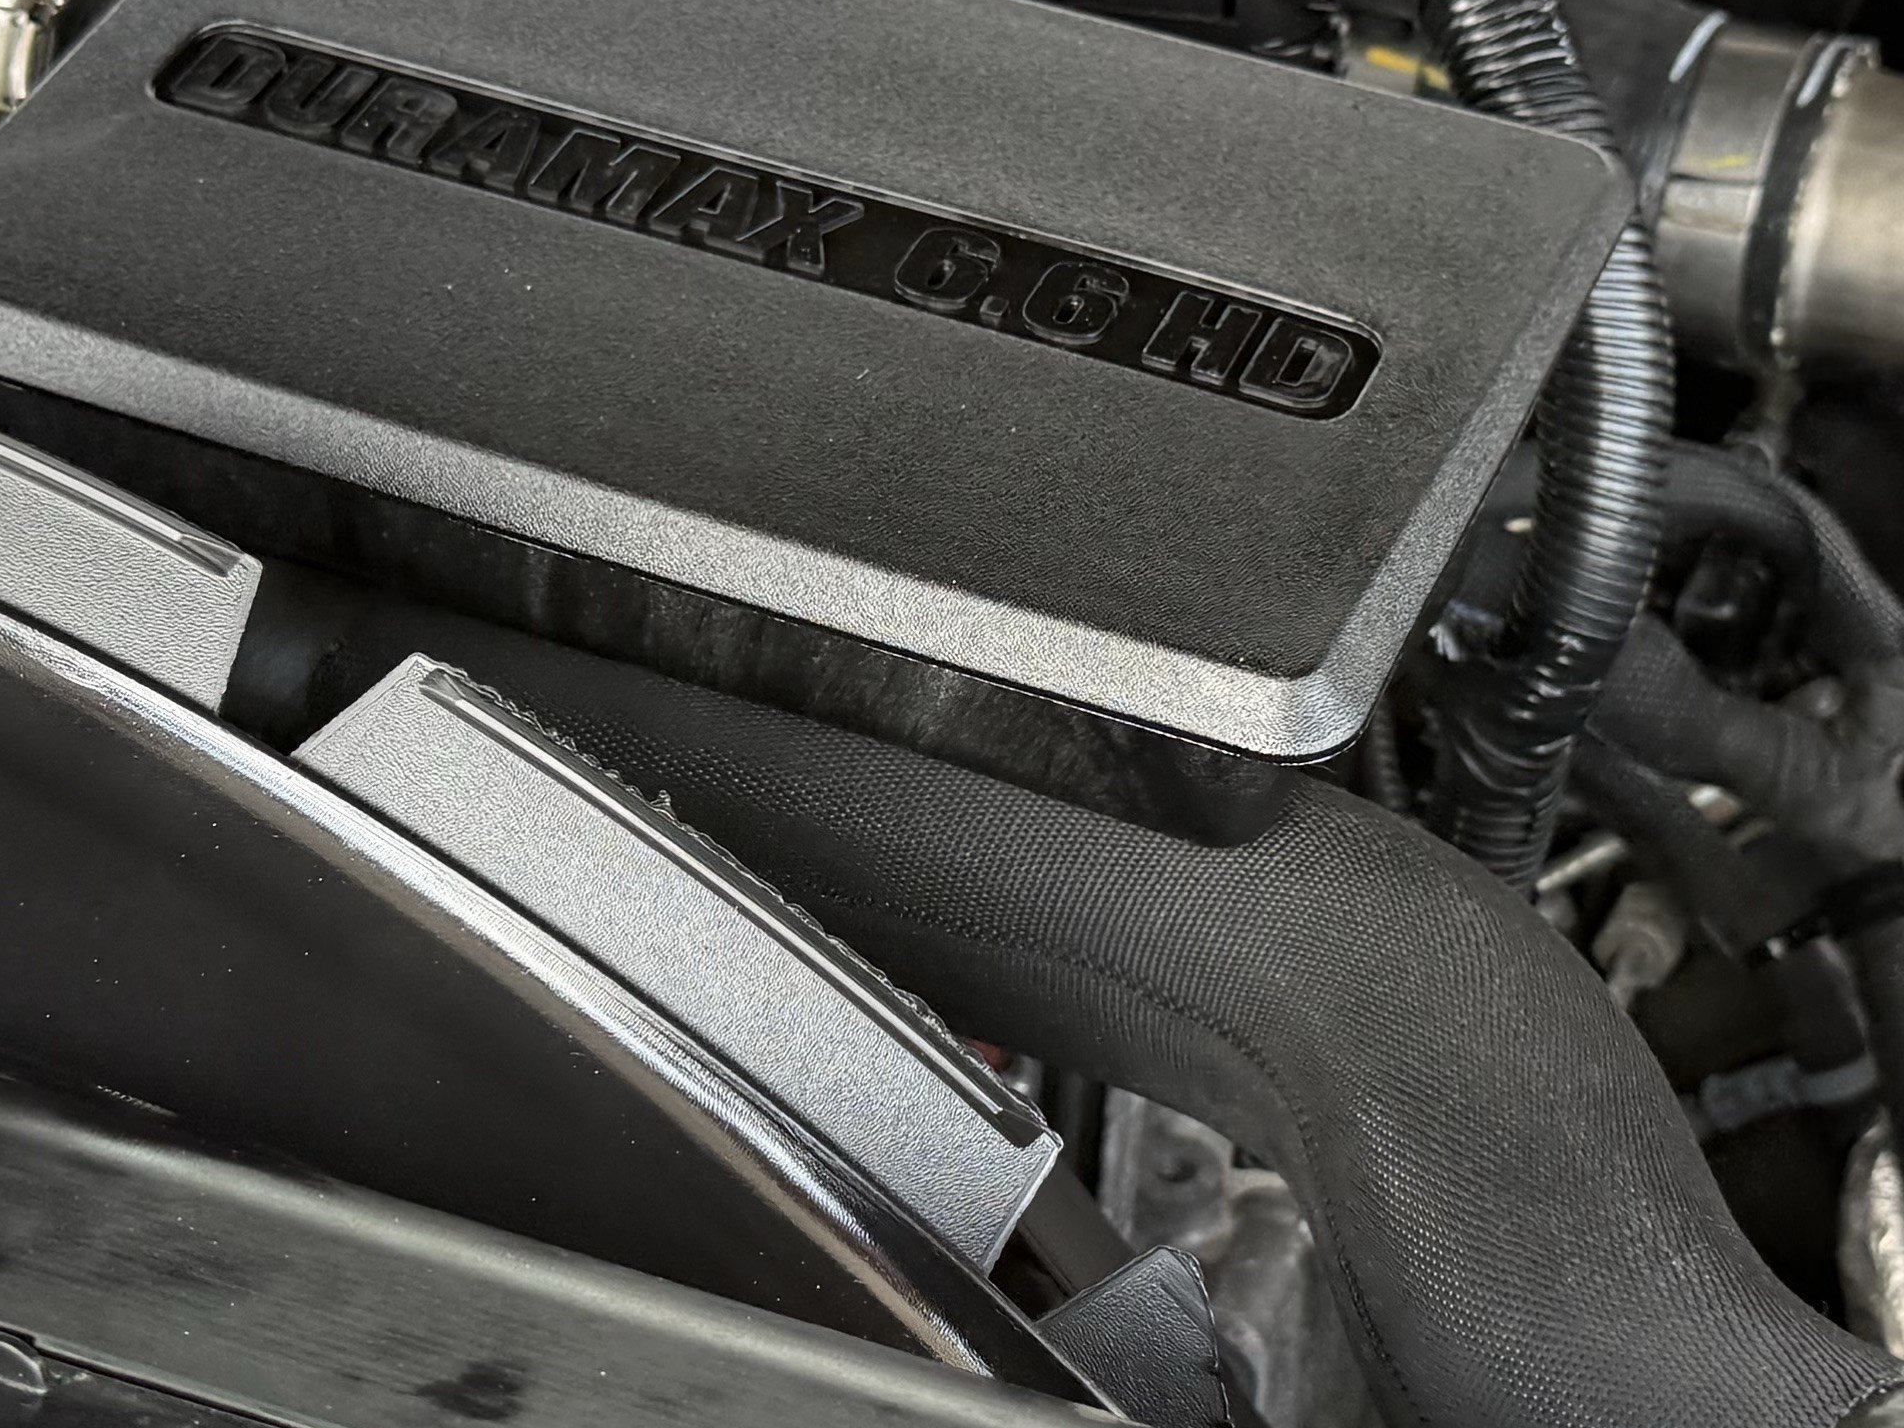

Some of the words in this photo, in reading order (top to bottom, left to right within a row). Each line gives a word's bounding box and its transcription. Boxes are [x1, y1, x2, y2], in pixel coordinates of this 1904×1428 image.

[162, 30, 864, 276] DURAMAX
[894, 226, 1132, 348] 6.6
[1141, 290, 1372, 412] HD
